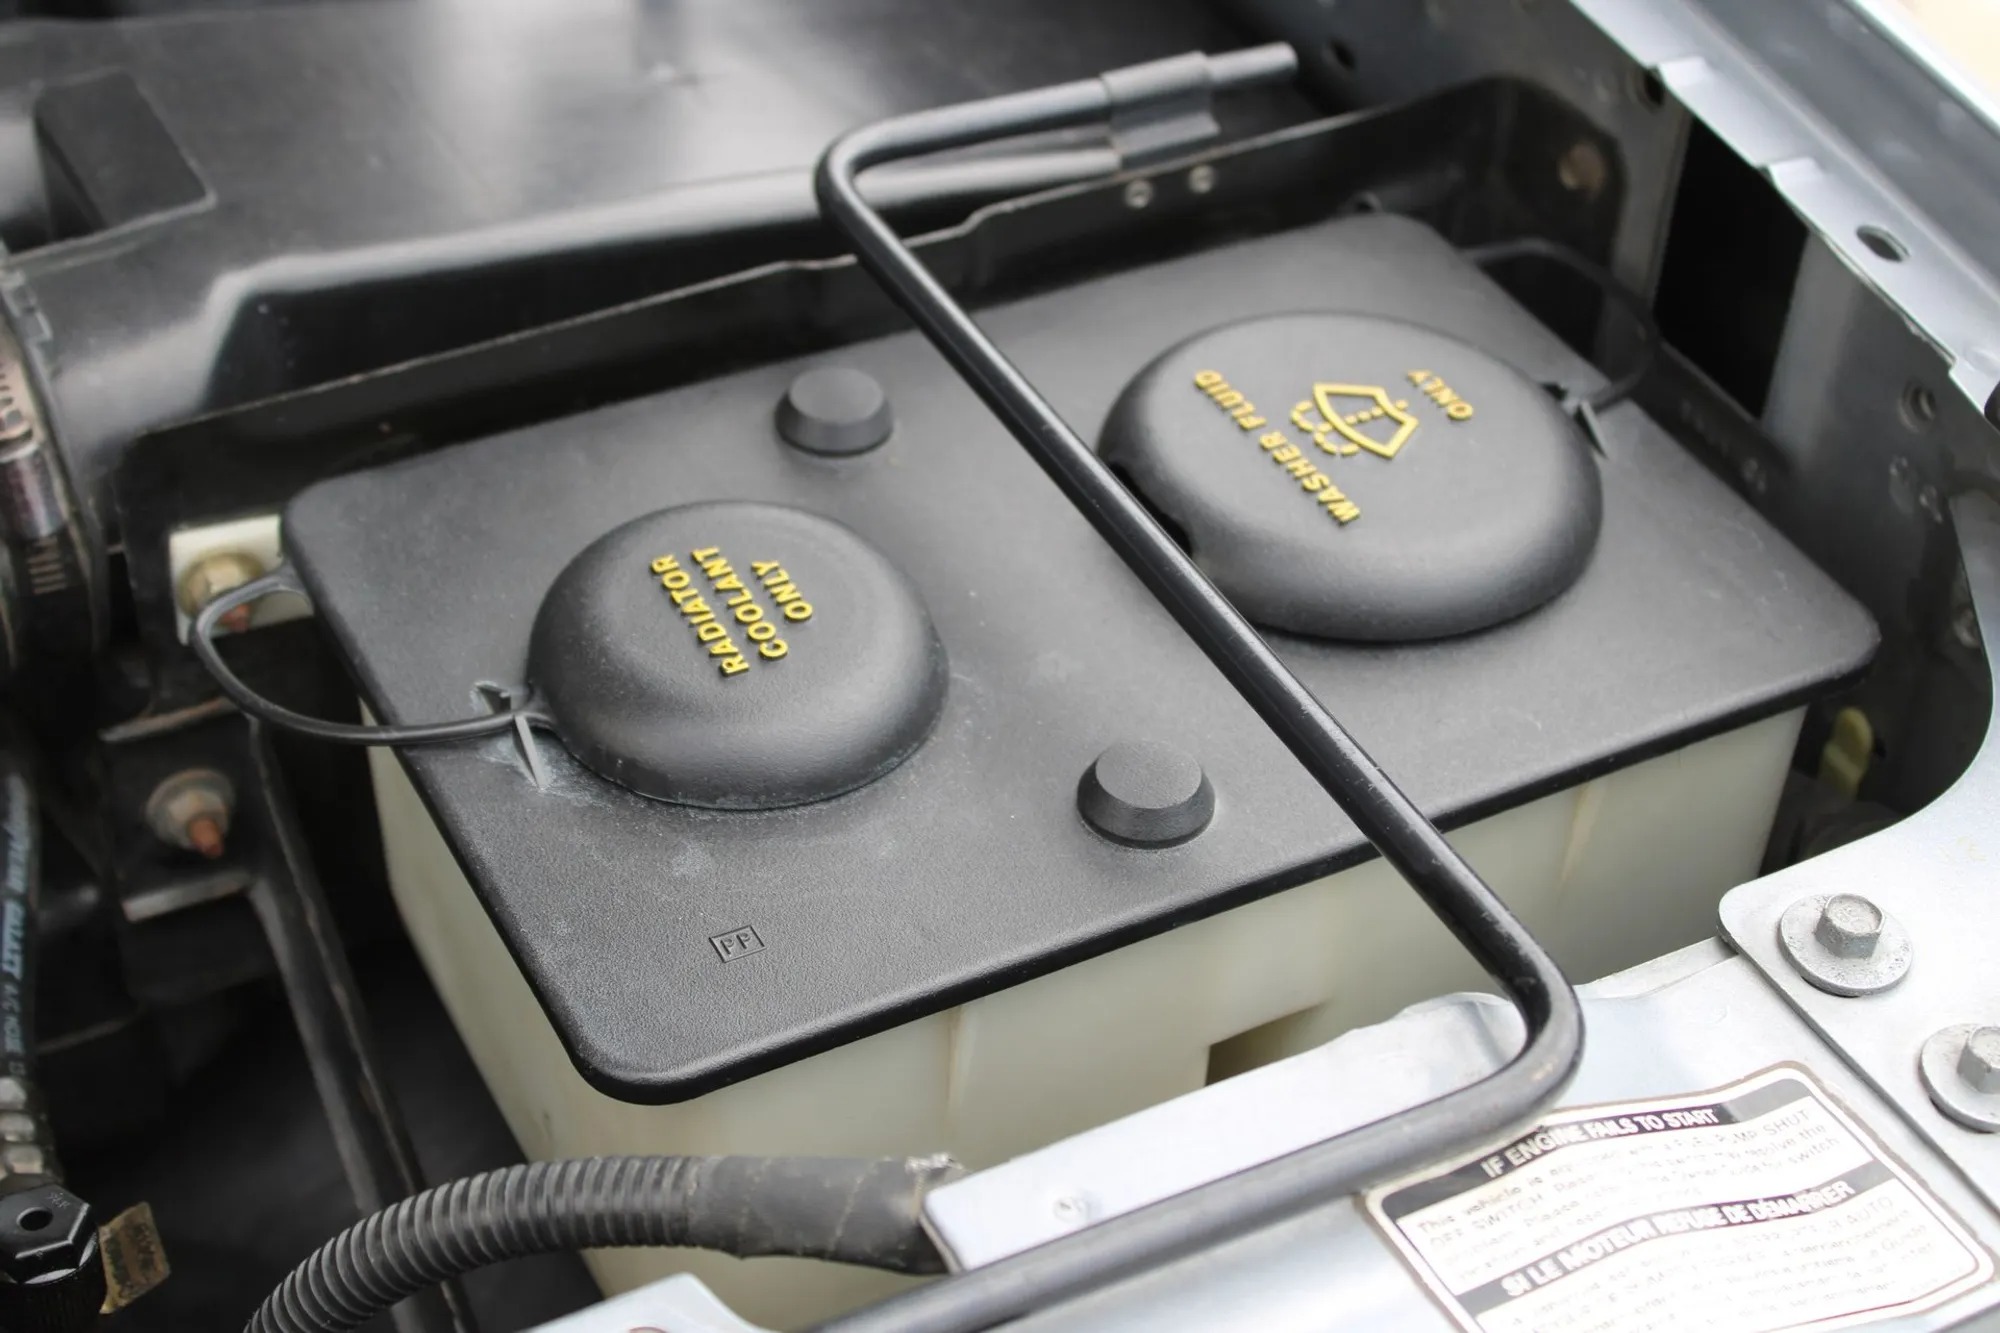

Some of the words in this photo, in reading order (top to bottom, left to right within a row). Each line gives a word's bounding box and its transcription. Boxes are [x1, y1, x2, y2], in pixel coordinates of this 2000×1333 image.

[1194, 369, 1267, 431] FLUID
[1405, 368, 1473, 421] ONLY
[1260, 431, 1361, 523] WASHER
[650, 554, 750, 677] RADIATOR
[691, 546, 790, 660] COOLANT
[751, 560, 814, 621] ONLY
[1482, 1158, 1502, 1177] IF
[1507, 1125, 1588, 1165] ENGINE
[1583, 1118, 1638, 1138] FAILS
[1633, 1115, 1664, 1130] TO
[1662, 1109, 1719, 1127] START
[1761, 1109, 1810, 1136] SHUT
[1798, 1124, 1827, 1141] the
[1502, 1273, 1531, 1296] SI
[1527, 1259, 1562, 1285] LE
[1557, 1218, 1653, 1270] MOTEUR
[1650, 1206, 1727, 1235] REFUSE
[1722, 1205, 1753, 1223] DE
